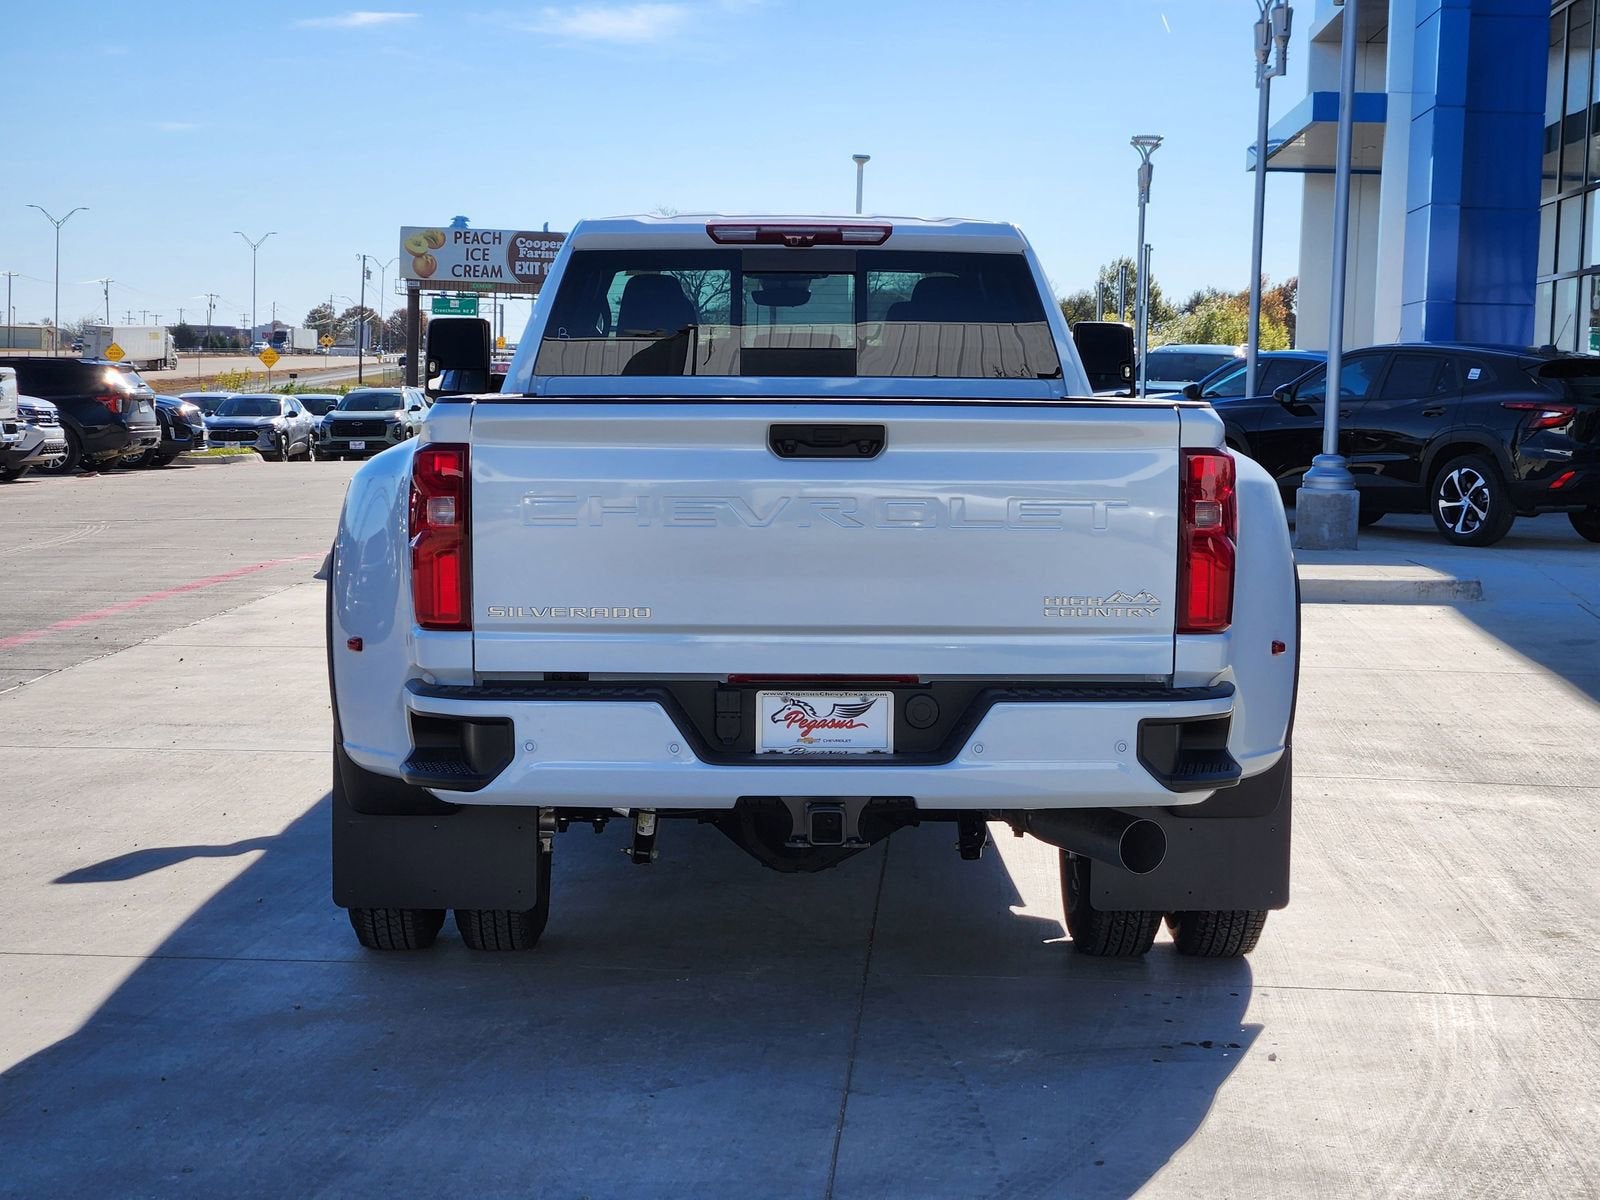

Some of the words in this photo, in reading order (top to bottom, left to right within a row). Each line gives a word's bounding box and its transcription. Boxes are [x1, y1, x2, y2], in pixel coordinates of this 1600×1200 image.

[454, 231, 502, 245] PEACH
[515, 237, 564, 250] Cooper
[465, 248, 490, 262] ICE
[451, 264, 503, 278] CREAM
[515, 261, 541, 275] EXIT
[520, 495, 1129, 530] CHEVROLET
[1043, 596, 1104, 606] HIGH
[487, 605, 652, 619] SILVERADO
[1043, 607, 1161, 617] COUNTRY
[784, 710, 869, 737] Pegasus
